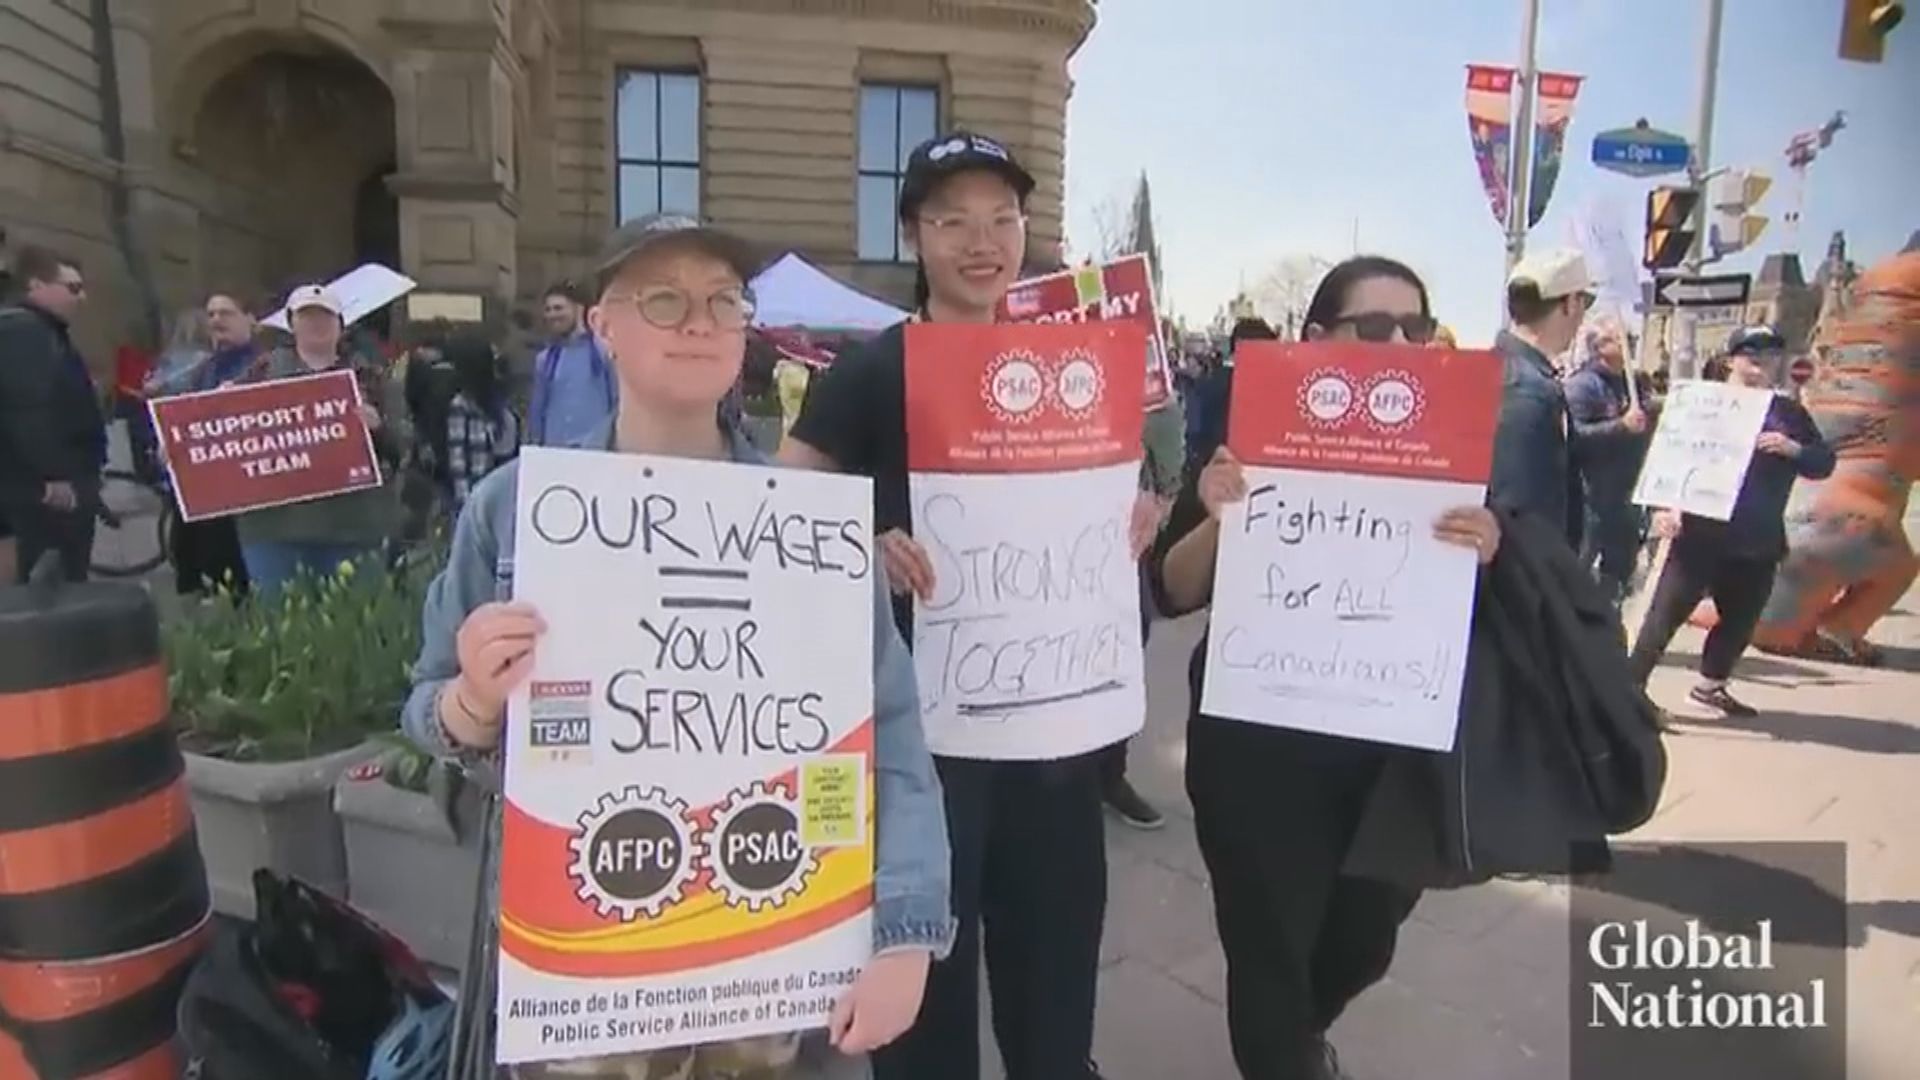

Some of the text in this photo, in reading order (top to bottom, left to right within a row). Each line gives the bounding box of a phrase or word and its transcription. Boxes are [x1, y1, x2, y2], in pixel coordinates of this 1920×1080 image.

[1101, 292, 1139, 320] MY
[998, 377, 1037, 397] PSAC
[1312, 389, 1347, 408] PSAC
[1373, 392, 1411, 411] AFPC
[171, 399, 348, 442] I SUPPORT MY
[189, 422, 347, 464] BARGAINING
[241, 452, 311, 478] TEAM
[532, 484, 870, 579] OUR WAGES
[1244, 485, 1412, 580] Fighting
[1258, 562, 1394, 613] for ALL
[638, 616, 764, 678] YOUR
[532, 720, 588, 743] TEAM
[606, 669, 829, 755] SERVICES
[595, 838, 675, 874] AFPC
[727, 830, 799, 866] PSAC
[509, 997, 581, 1019] Alliance
[586, 993, 608, 1014] de
[613, 991, 629, 1010] la
[635, 986, 707, 1009] Fonction
[712, 978, 780, 1005] publique
[785, 973, 804, 992] du
[541, 996, 836, 1044] Public Service Alliance of Canada
